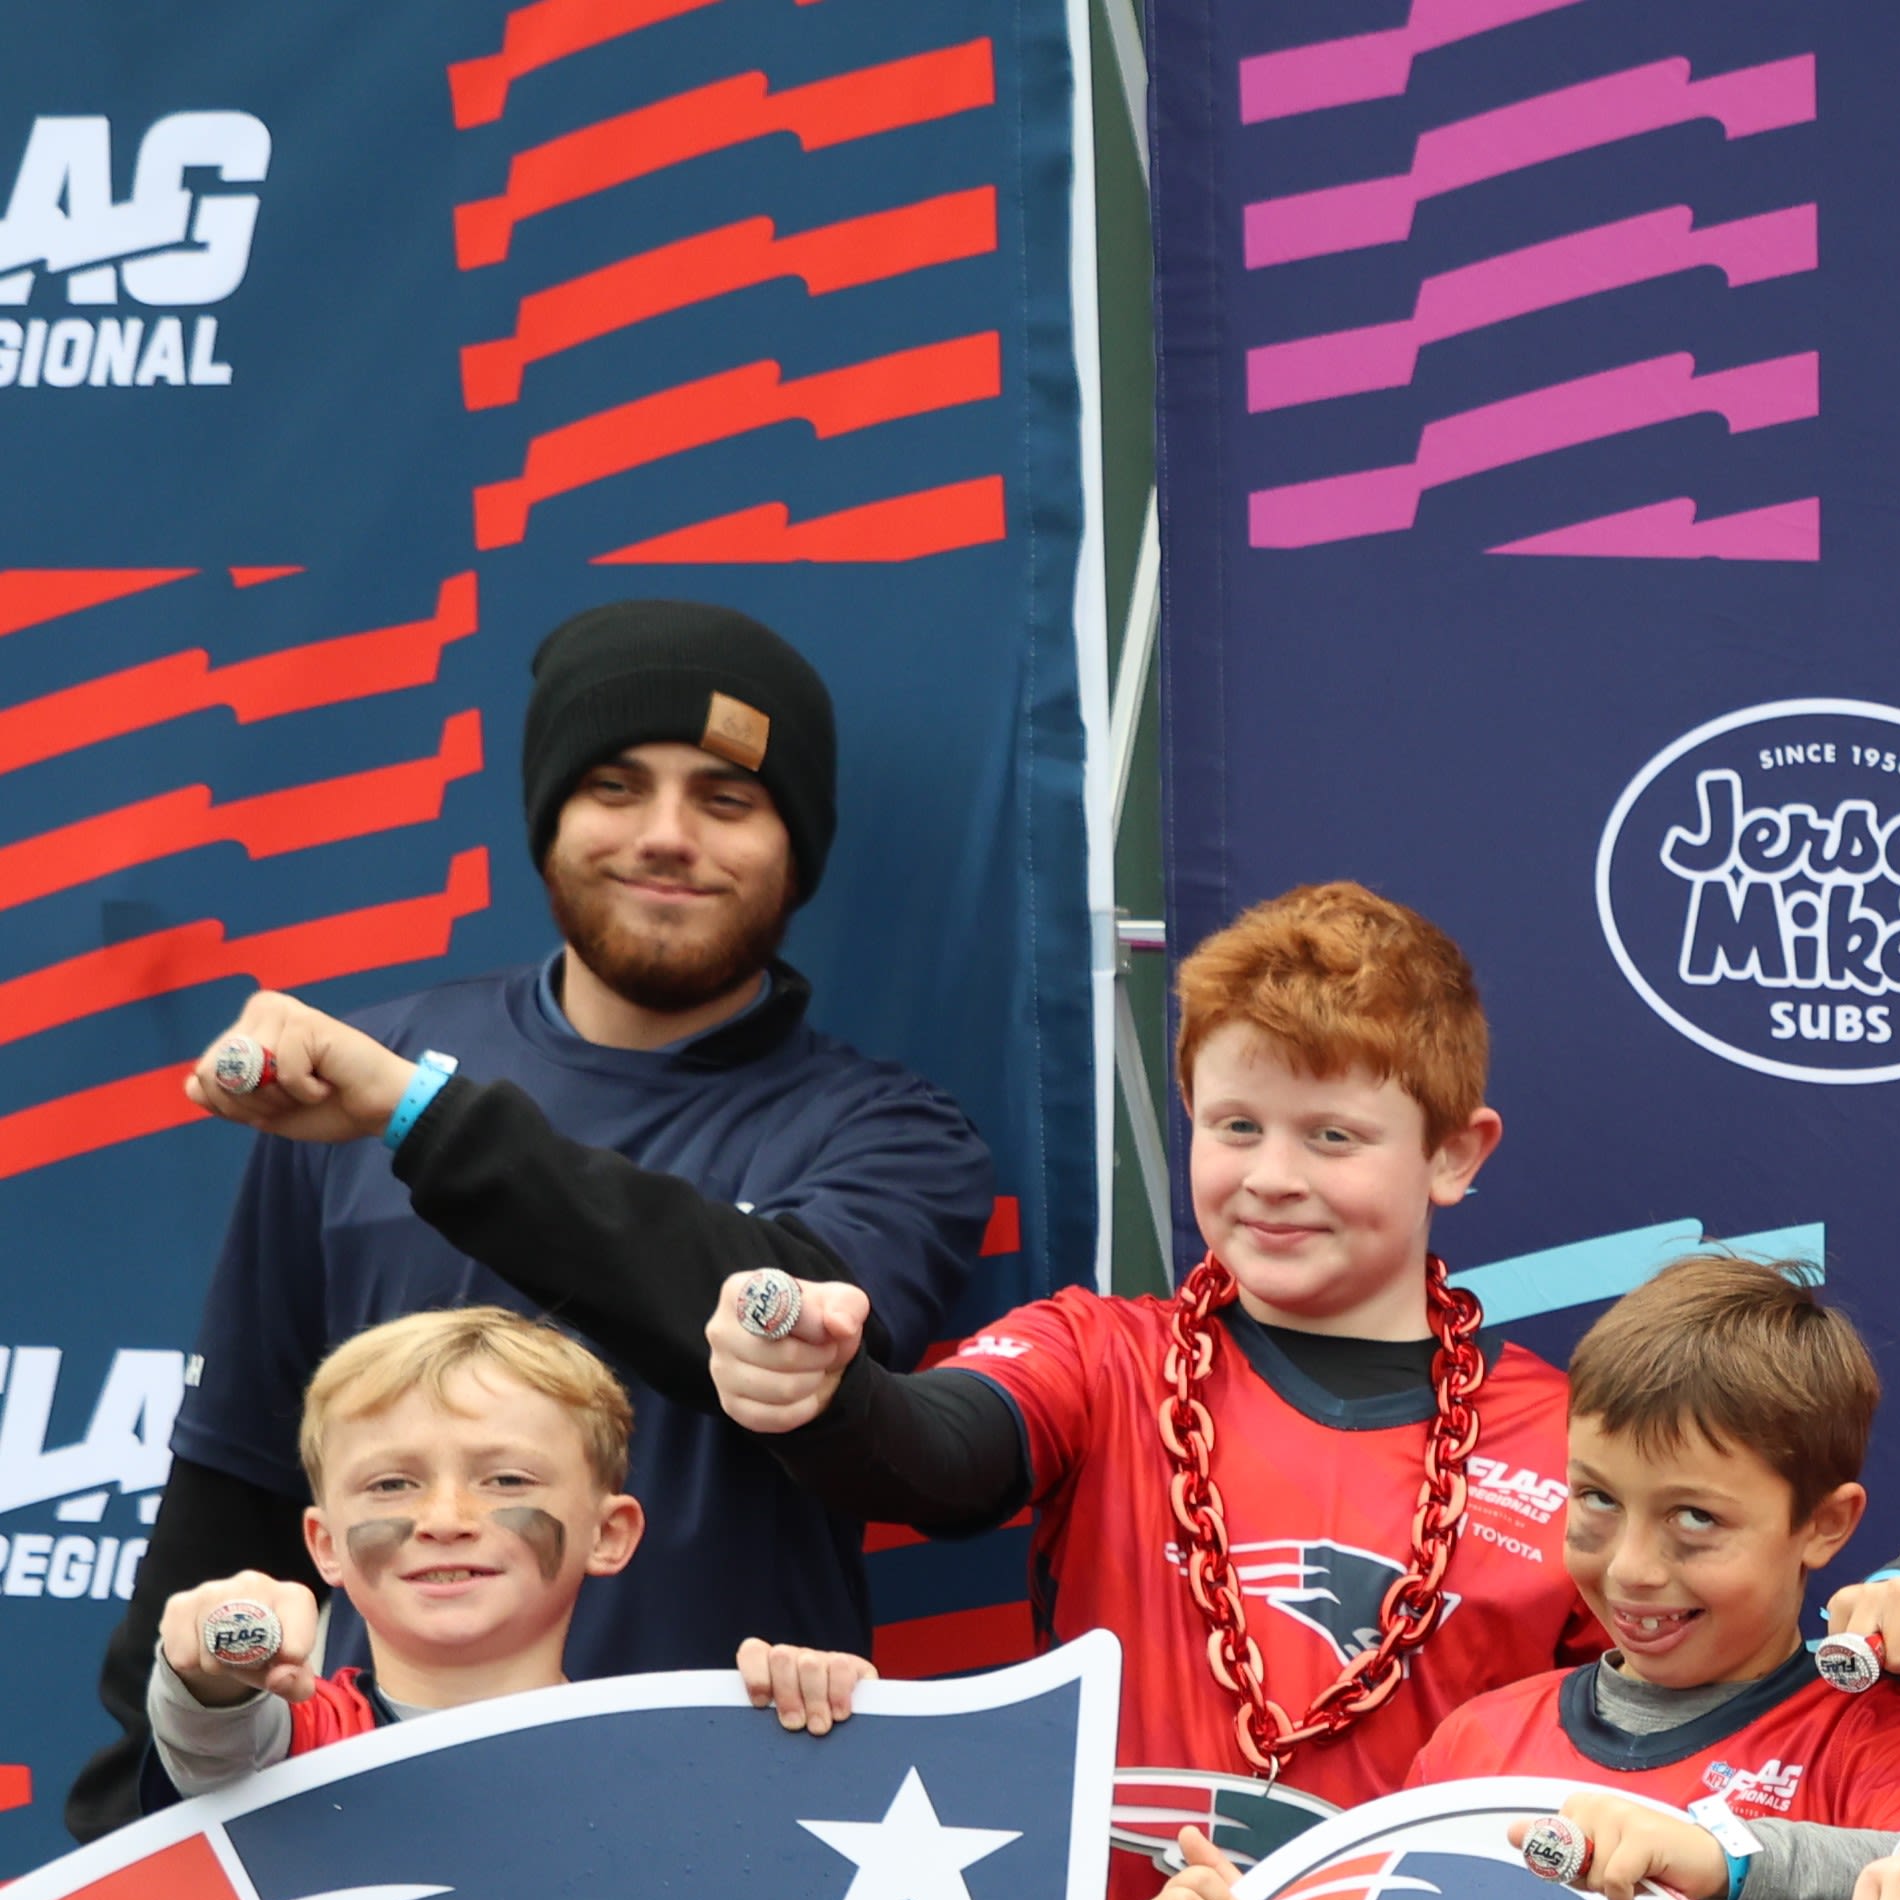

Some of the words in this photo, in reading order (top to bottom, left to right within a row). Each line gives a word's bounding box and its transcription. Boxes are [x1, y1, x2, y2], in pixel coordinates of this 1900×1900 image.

[0, 110, 272, 306] AG
[1758, 743, 1837, 771] SINCE
[1769, 1001, 1893, 1044] SUBS
[1467, 1455, 1569, 1513] FLAG
[1472, 1522, 1543, 1563] TOYOTA
[214, 1628, 266, 1653] FLAG
[1524, 1839, 1564, 1867] FLAG
